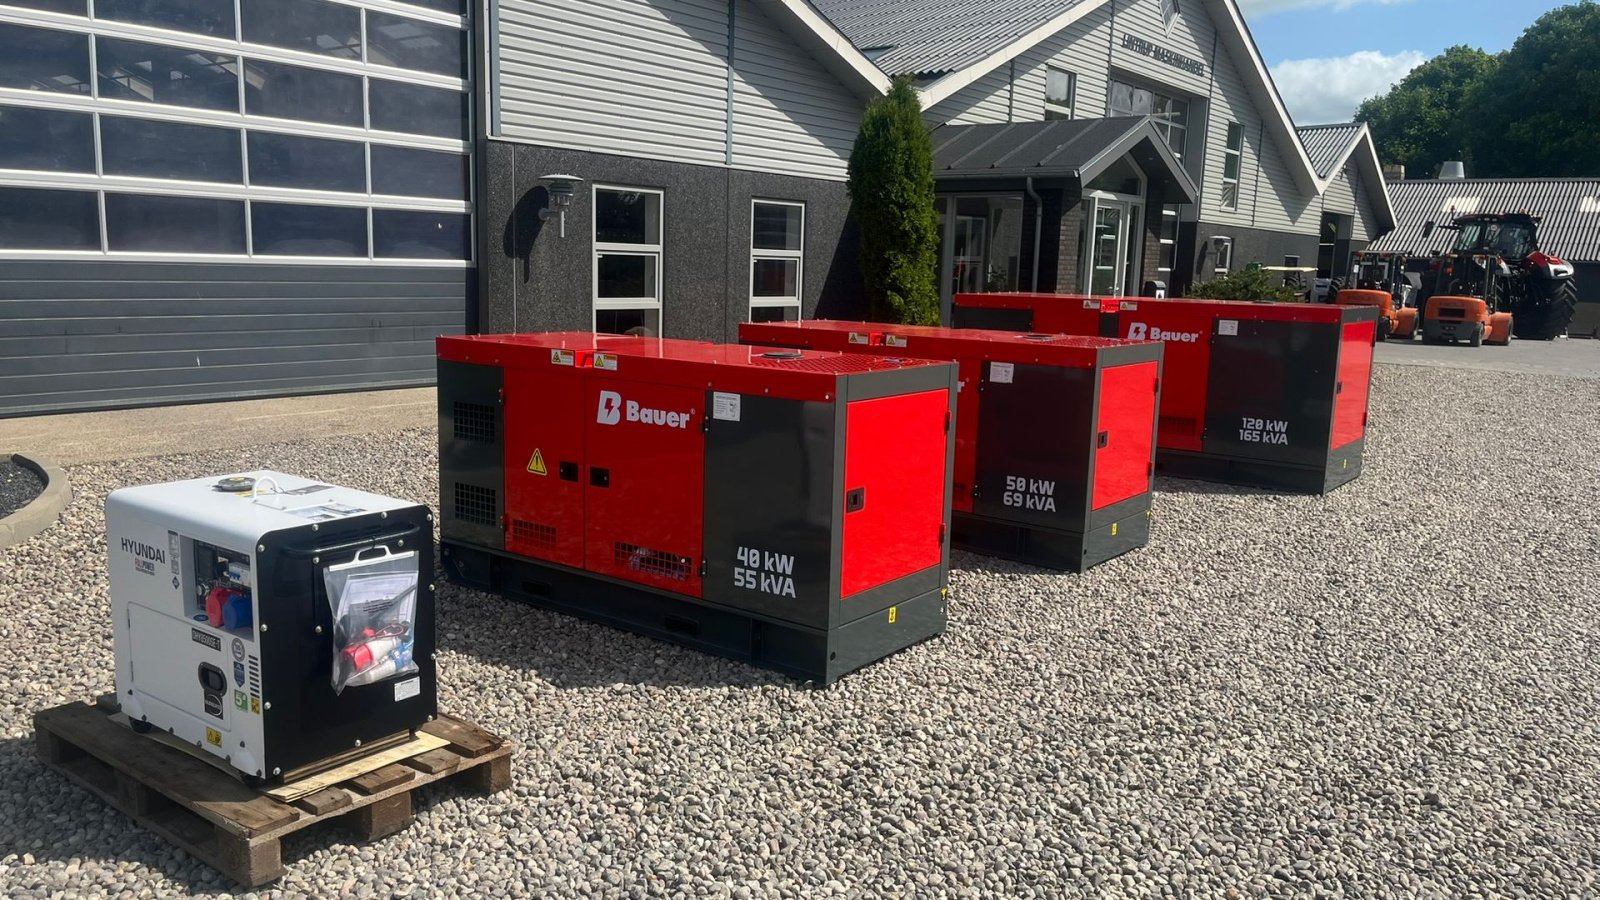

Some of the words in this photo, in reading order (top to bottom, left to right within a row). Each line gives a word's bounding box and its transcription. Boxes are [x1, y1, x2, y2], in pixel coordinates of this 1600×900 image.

[1150, 327, 1199, 343] Bauer
[626, 400, 690, 429] Bauer
[1242, 417, 1264, 430] 120
[1266, 419, 1288, 433] kW
[1239, 429, 1261, 442] 165
[1262, 431, 1289, 446] kVA
[1006, 475, 1026, 492] 50
[1029, 479, 1056, 496] kW
[1003, 491, 1023, 507] 69
[1025, 494, 1056, 512] kVA
[121, 537, 166, 565] HYUNDAI
[737, 546, 760, 569] 40
[764, 551, 795, 576] kW
[734, 567, 757, 590] 55
[761, 573, 796, 599] kVA
